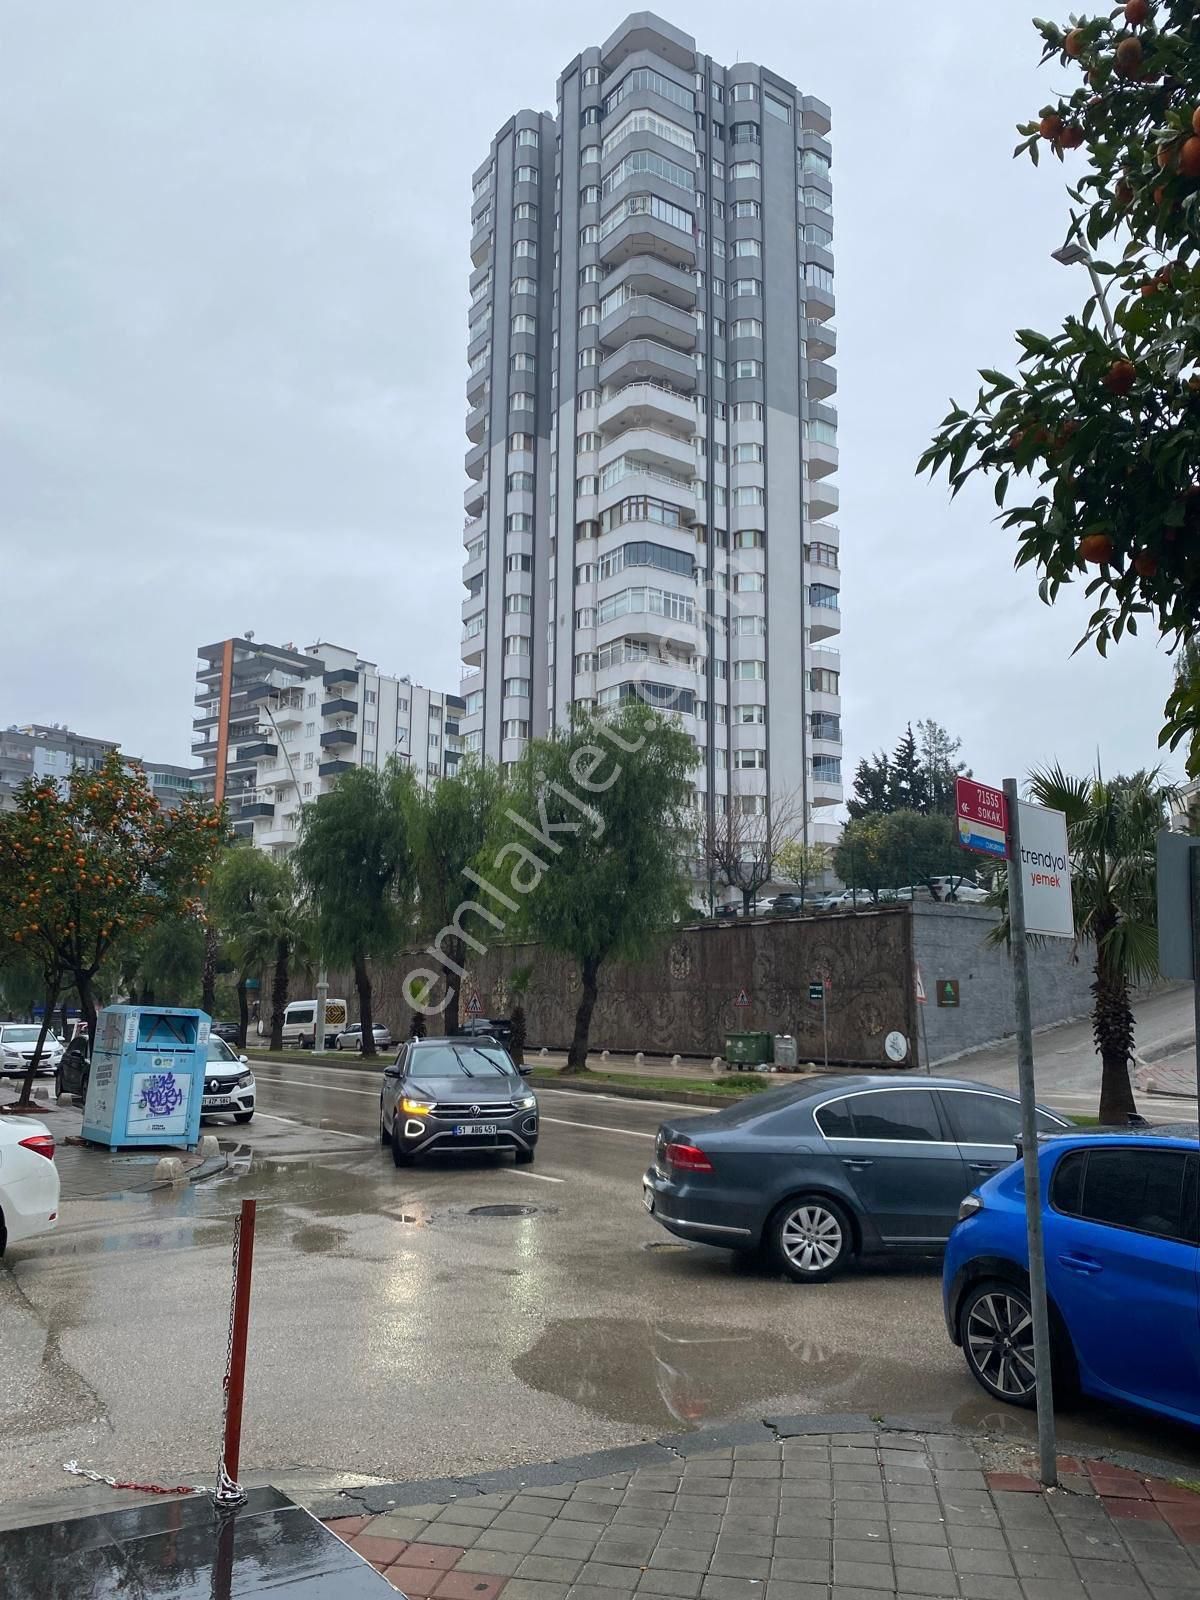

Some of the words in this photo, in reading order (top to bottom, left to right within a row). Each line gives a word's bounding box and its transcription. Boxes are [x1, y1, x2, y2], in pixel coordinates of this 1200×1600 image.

[977, 789, 999, 808] 71555
[977, 806, 1001, 823] SOKAK
[1020, 845, 1067, 872] trendyol
[1031, 872, 1061, 887] yemek
